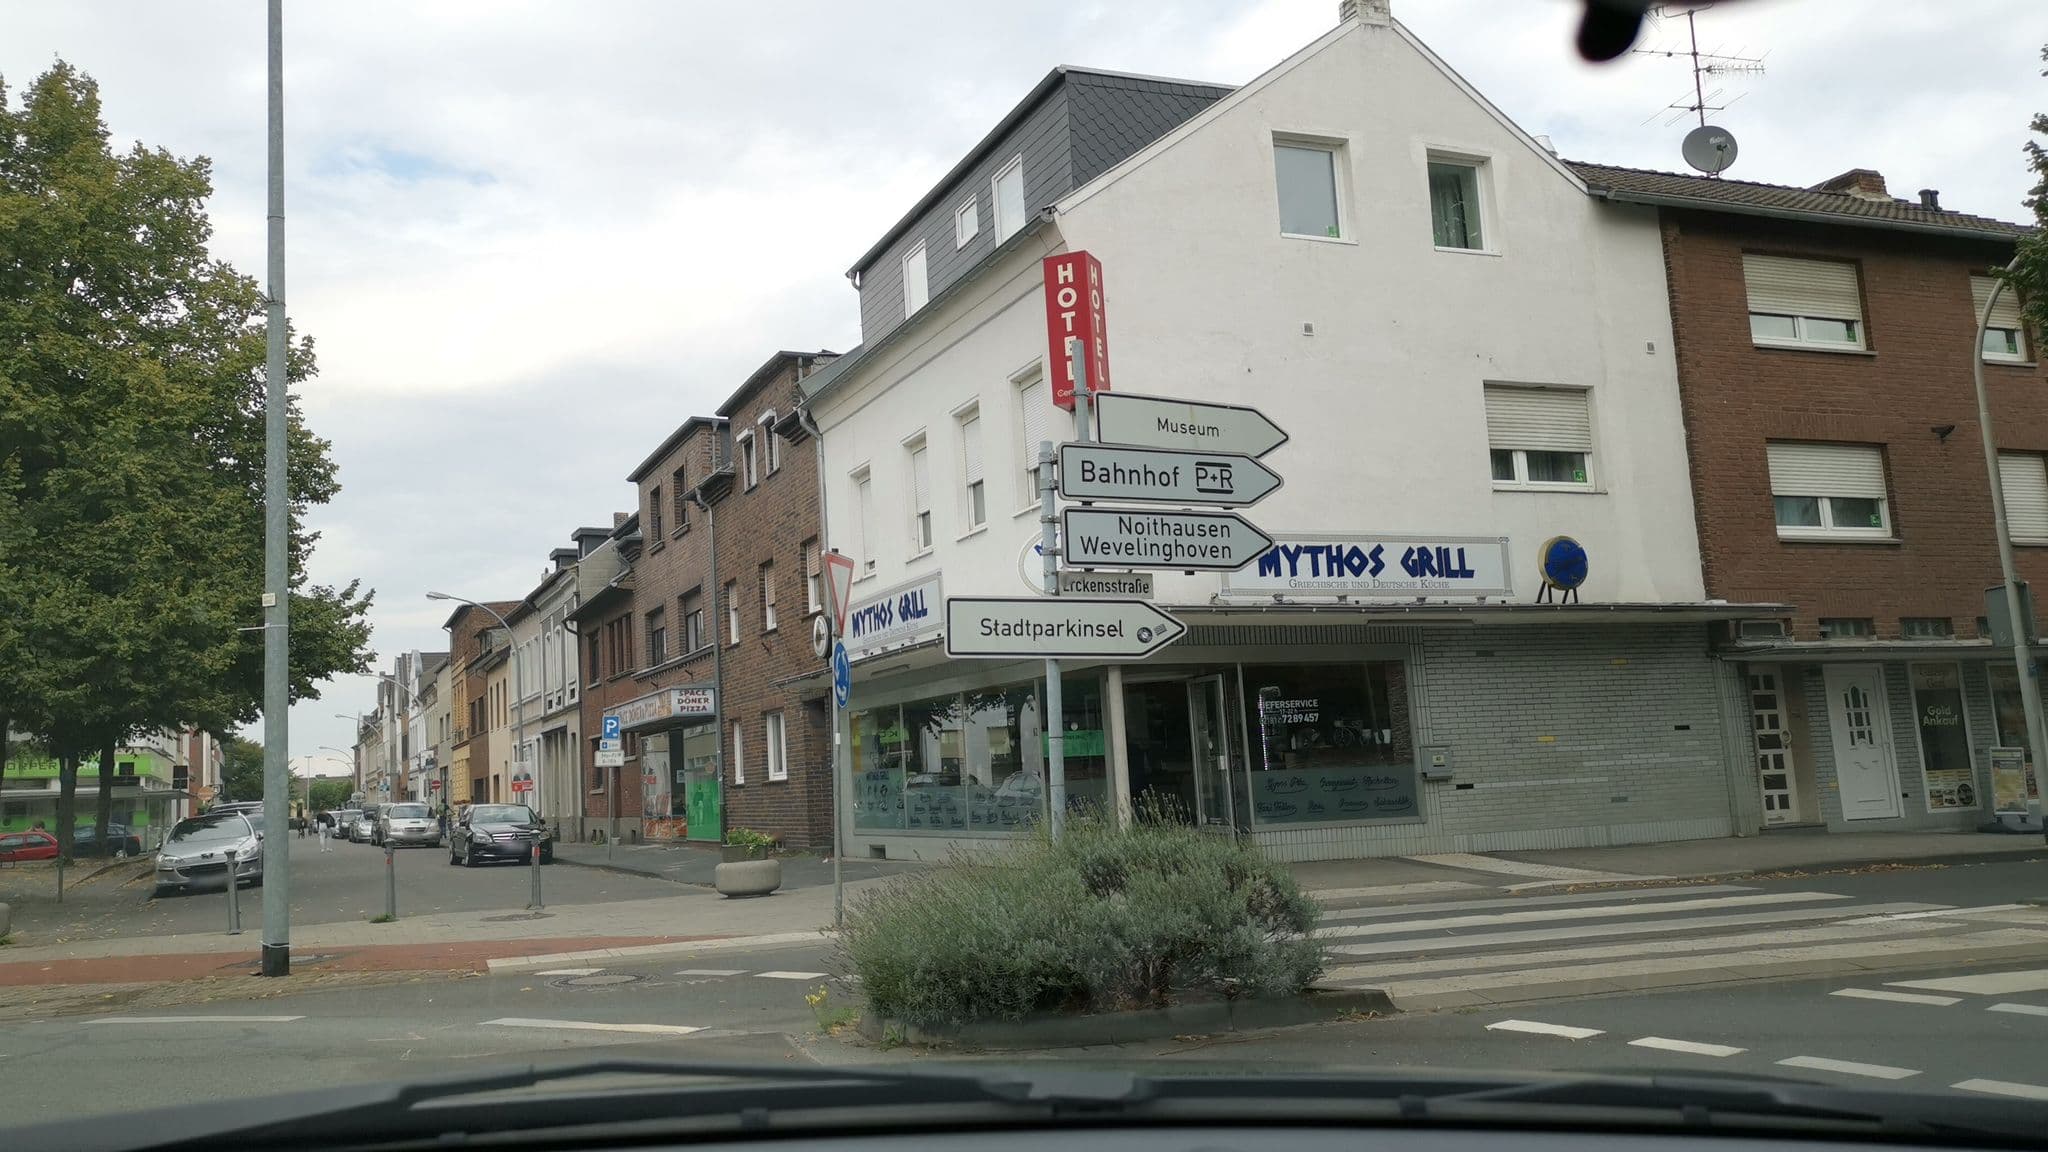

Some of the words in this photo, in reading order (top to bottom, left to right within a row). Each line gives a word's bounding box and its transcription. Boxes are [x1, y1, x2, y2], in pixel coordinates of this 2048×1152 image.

[1057, 263, 1078, 381] HOTEL
[1090, 264, 1105, 382] HOTEL
[1157, 417, 1220, 438] Museum
[1081, 460, 1180, 487] Bahnhof
[1195, 466, 1233, 489] P+R
[1118, 516, 1231, 538] Noithausen
[1080, 536, 1232, 561] Wevelinghoven
[1257, 543, 1386, 578] MYTHOS
[1400, 545, 1475, 579] GRILL
[851, 597, 894, 639] MYTHOS
[898, 588, 928, 623] GRILL
[980, 617, 1124, 641] Stadtparkinsel
[678, 689, 707, 697] SPACE
[680, 705, 708, 713] PIZZA
[1282, 713, 1319, 725] 7289457
[1927, 705, 1952, 716] Gold
[606, 719, 617, 733] P
[1923, 714, 1959, 727] Ankauf
